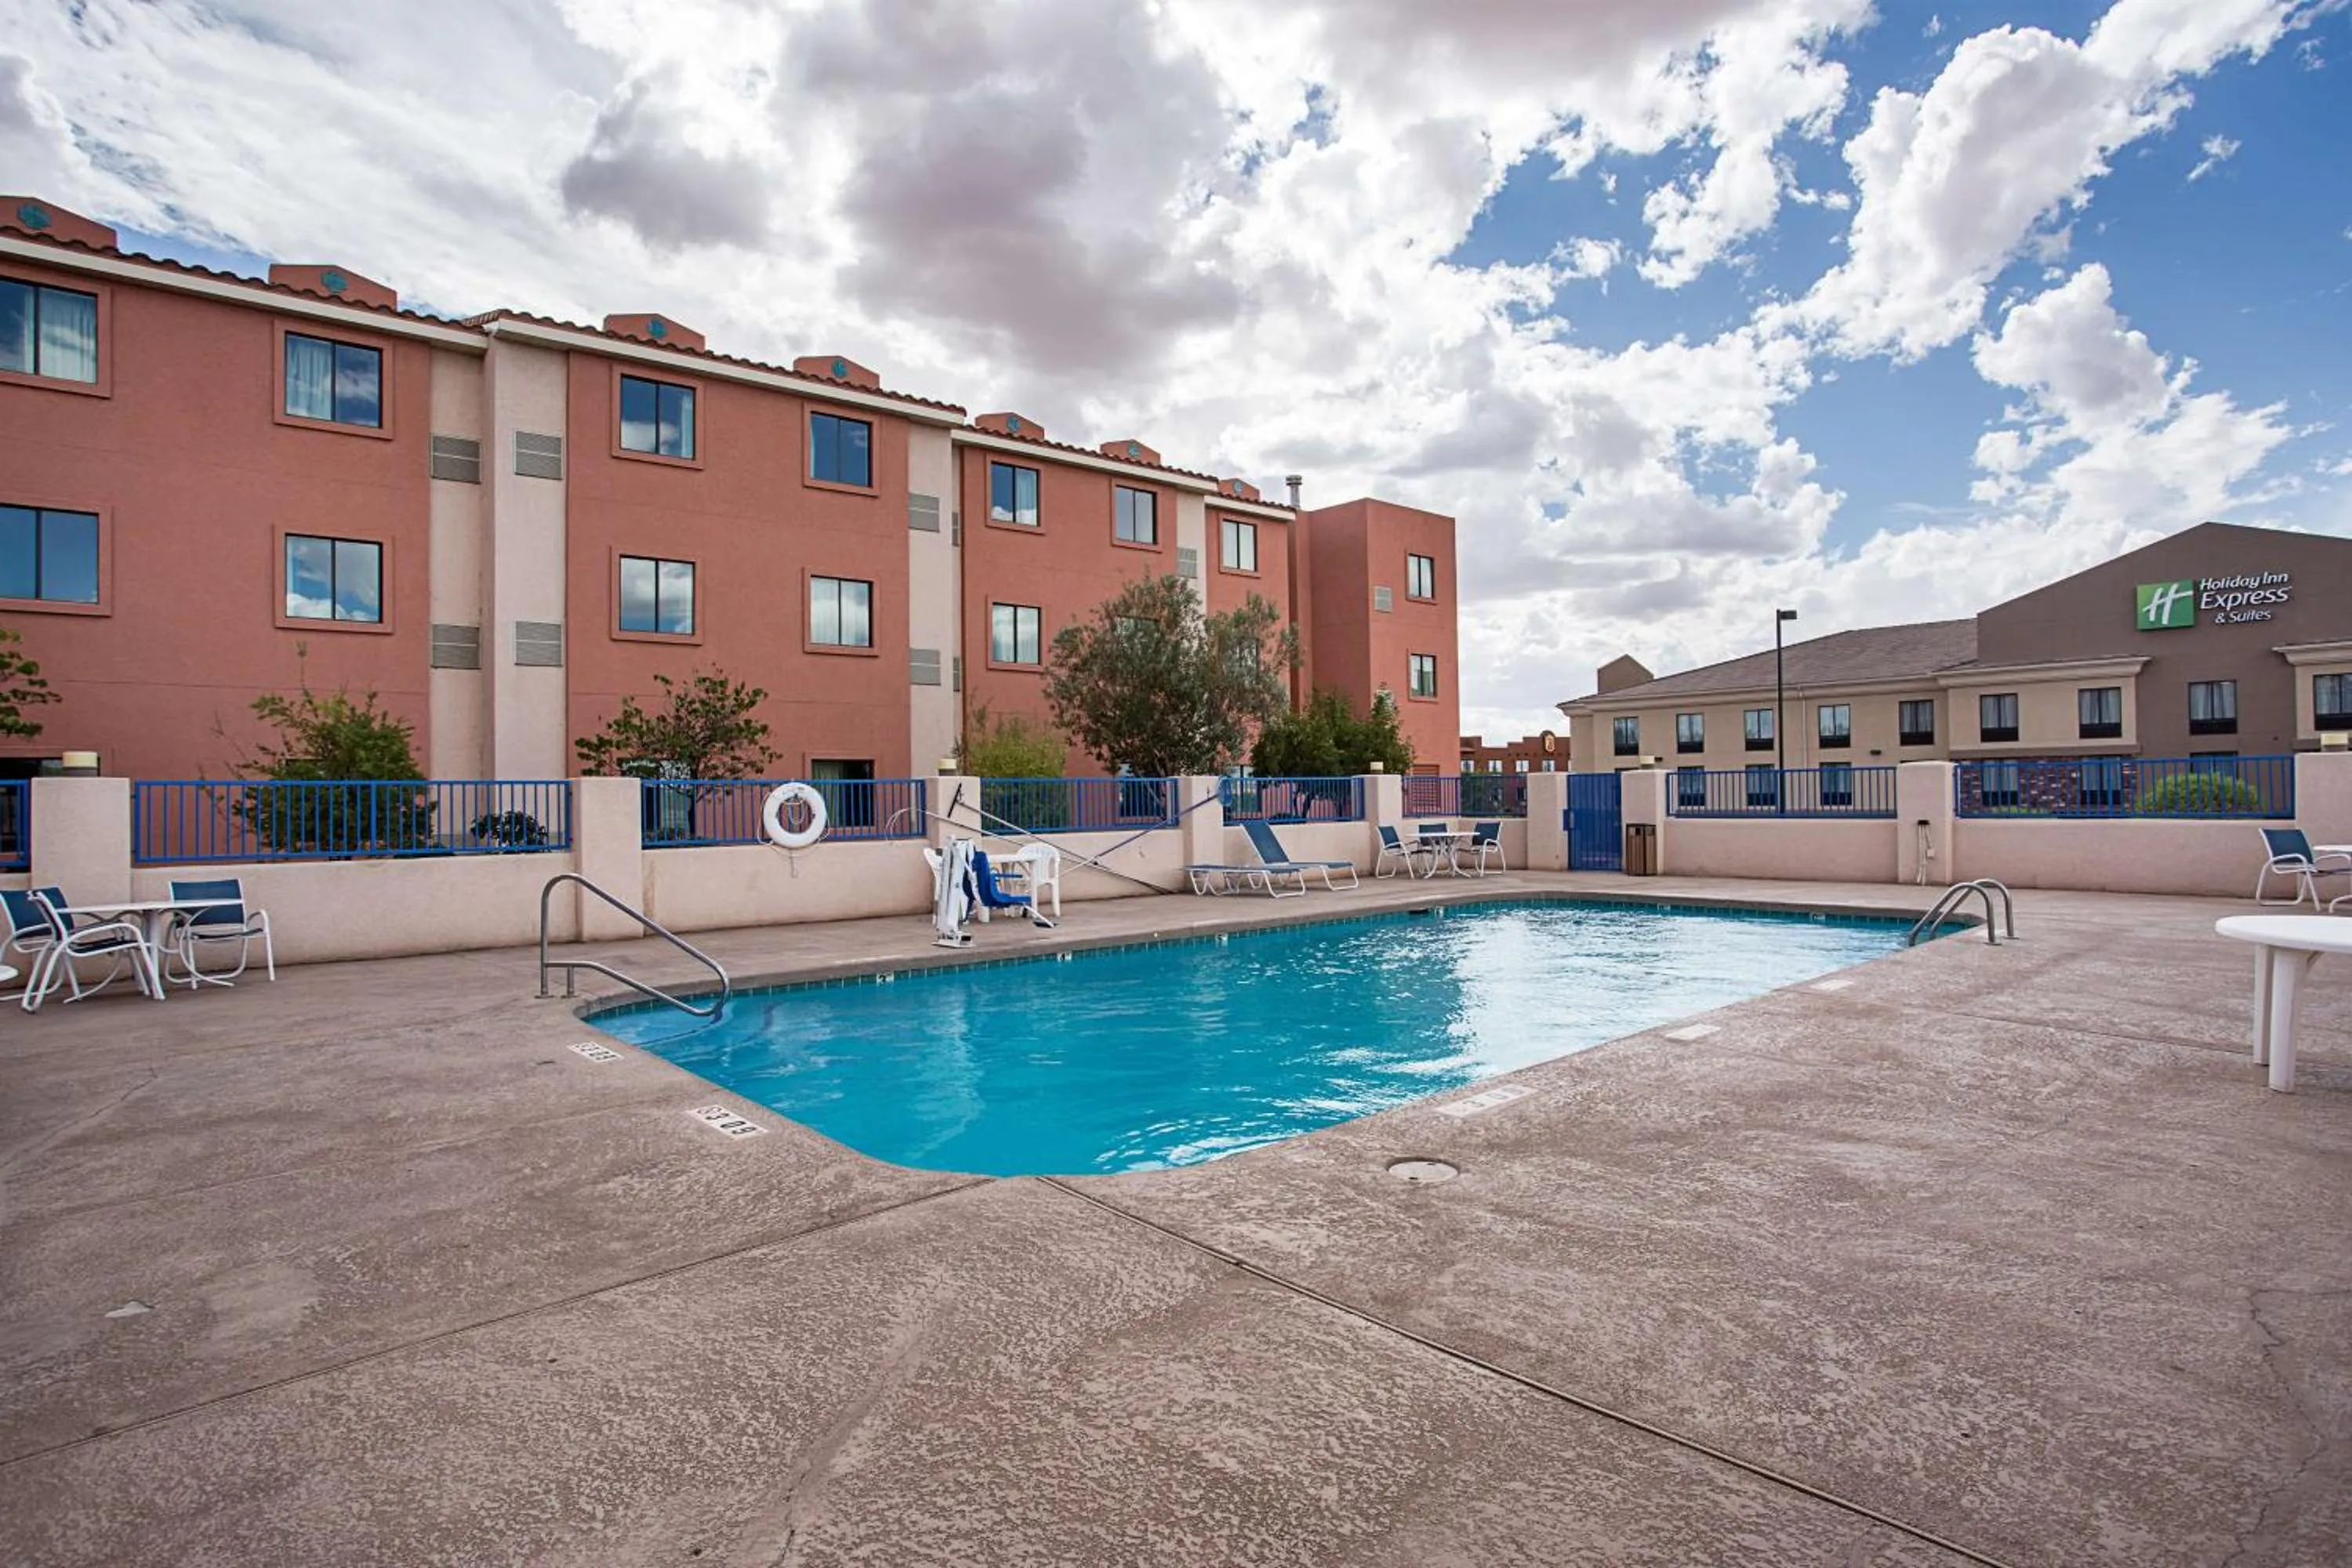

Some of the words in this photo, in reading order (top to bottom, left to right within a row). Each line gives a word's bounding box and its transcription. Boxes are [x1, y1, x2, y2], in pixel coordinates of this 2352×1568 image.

[2200, 574, 2259, 590] Holiday
[2263, 572, 2288, 585] Inn
[2200, 587, 2288, 610] Express
[2215, 612, 2226, 623] &
[2230, 609, 2271, 622] Suites
